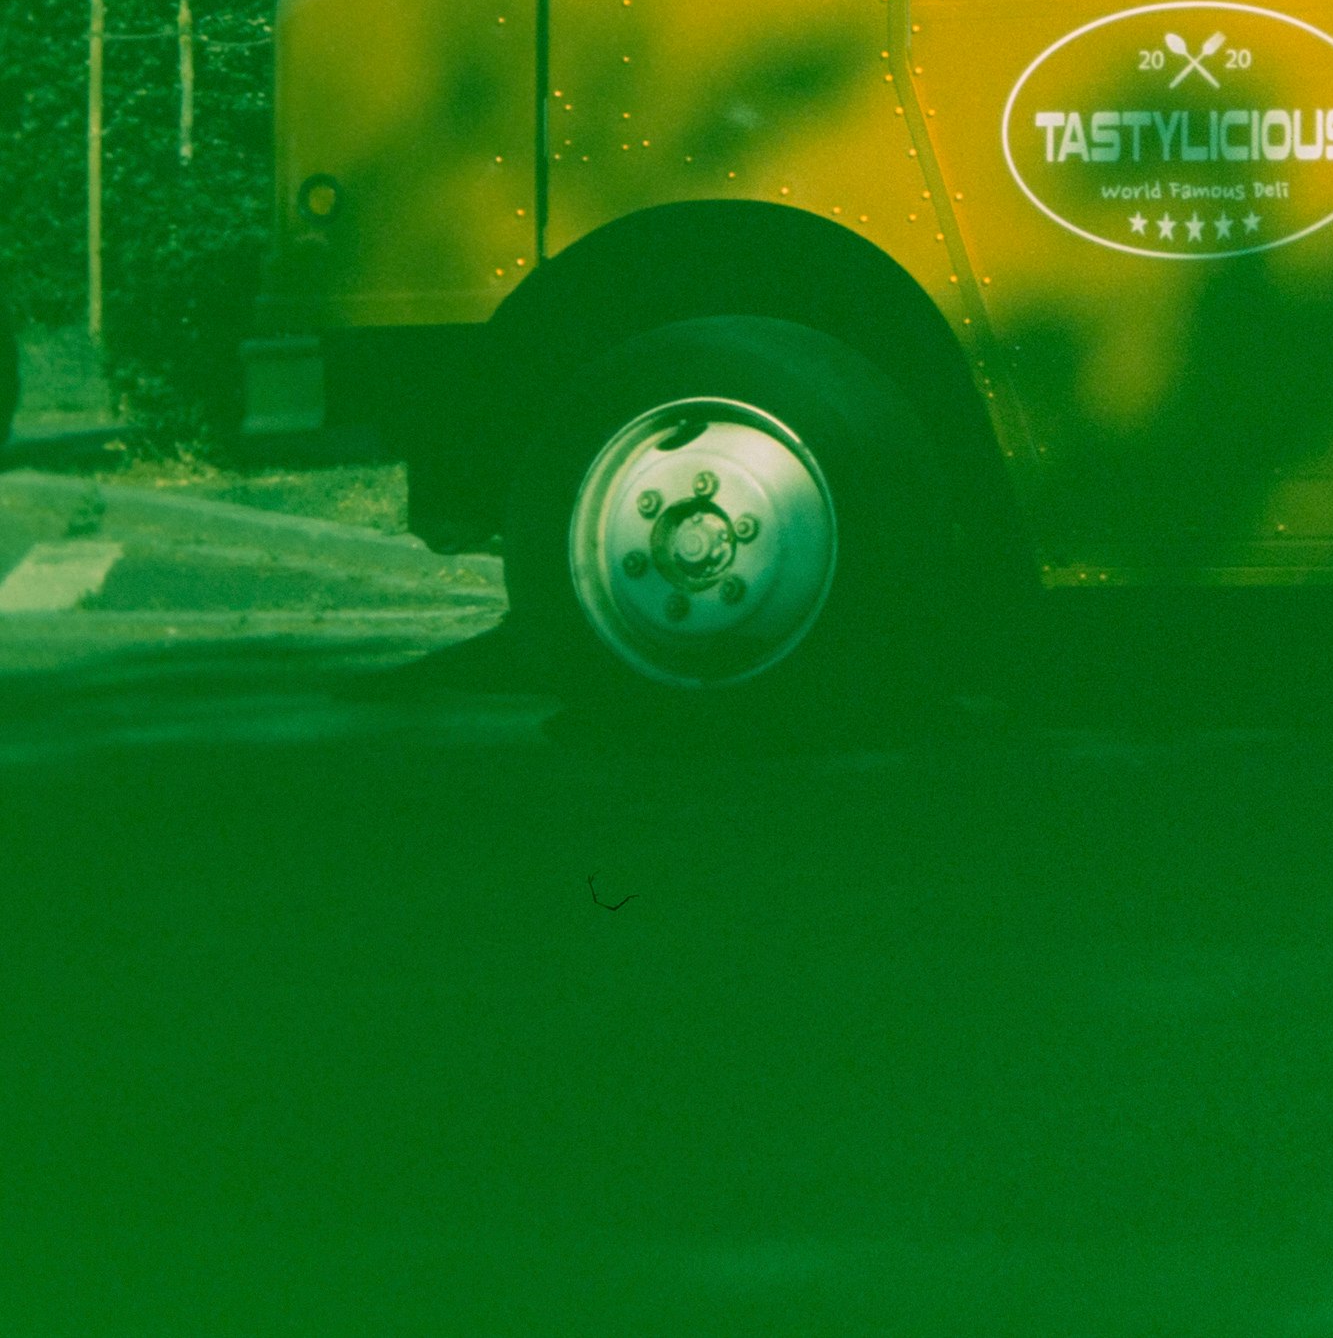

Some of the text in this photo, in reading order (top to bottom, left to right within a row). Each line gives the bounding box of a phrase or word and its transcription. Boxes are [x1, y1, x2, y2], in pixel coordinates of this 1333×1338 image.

[1138, 49, 1252, 70] 20 20
[1169, 182, 1245, 201] Famous
[1254, 181, 1290, 199] Deli
